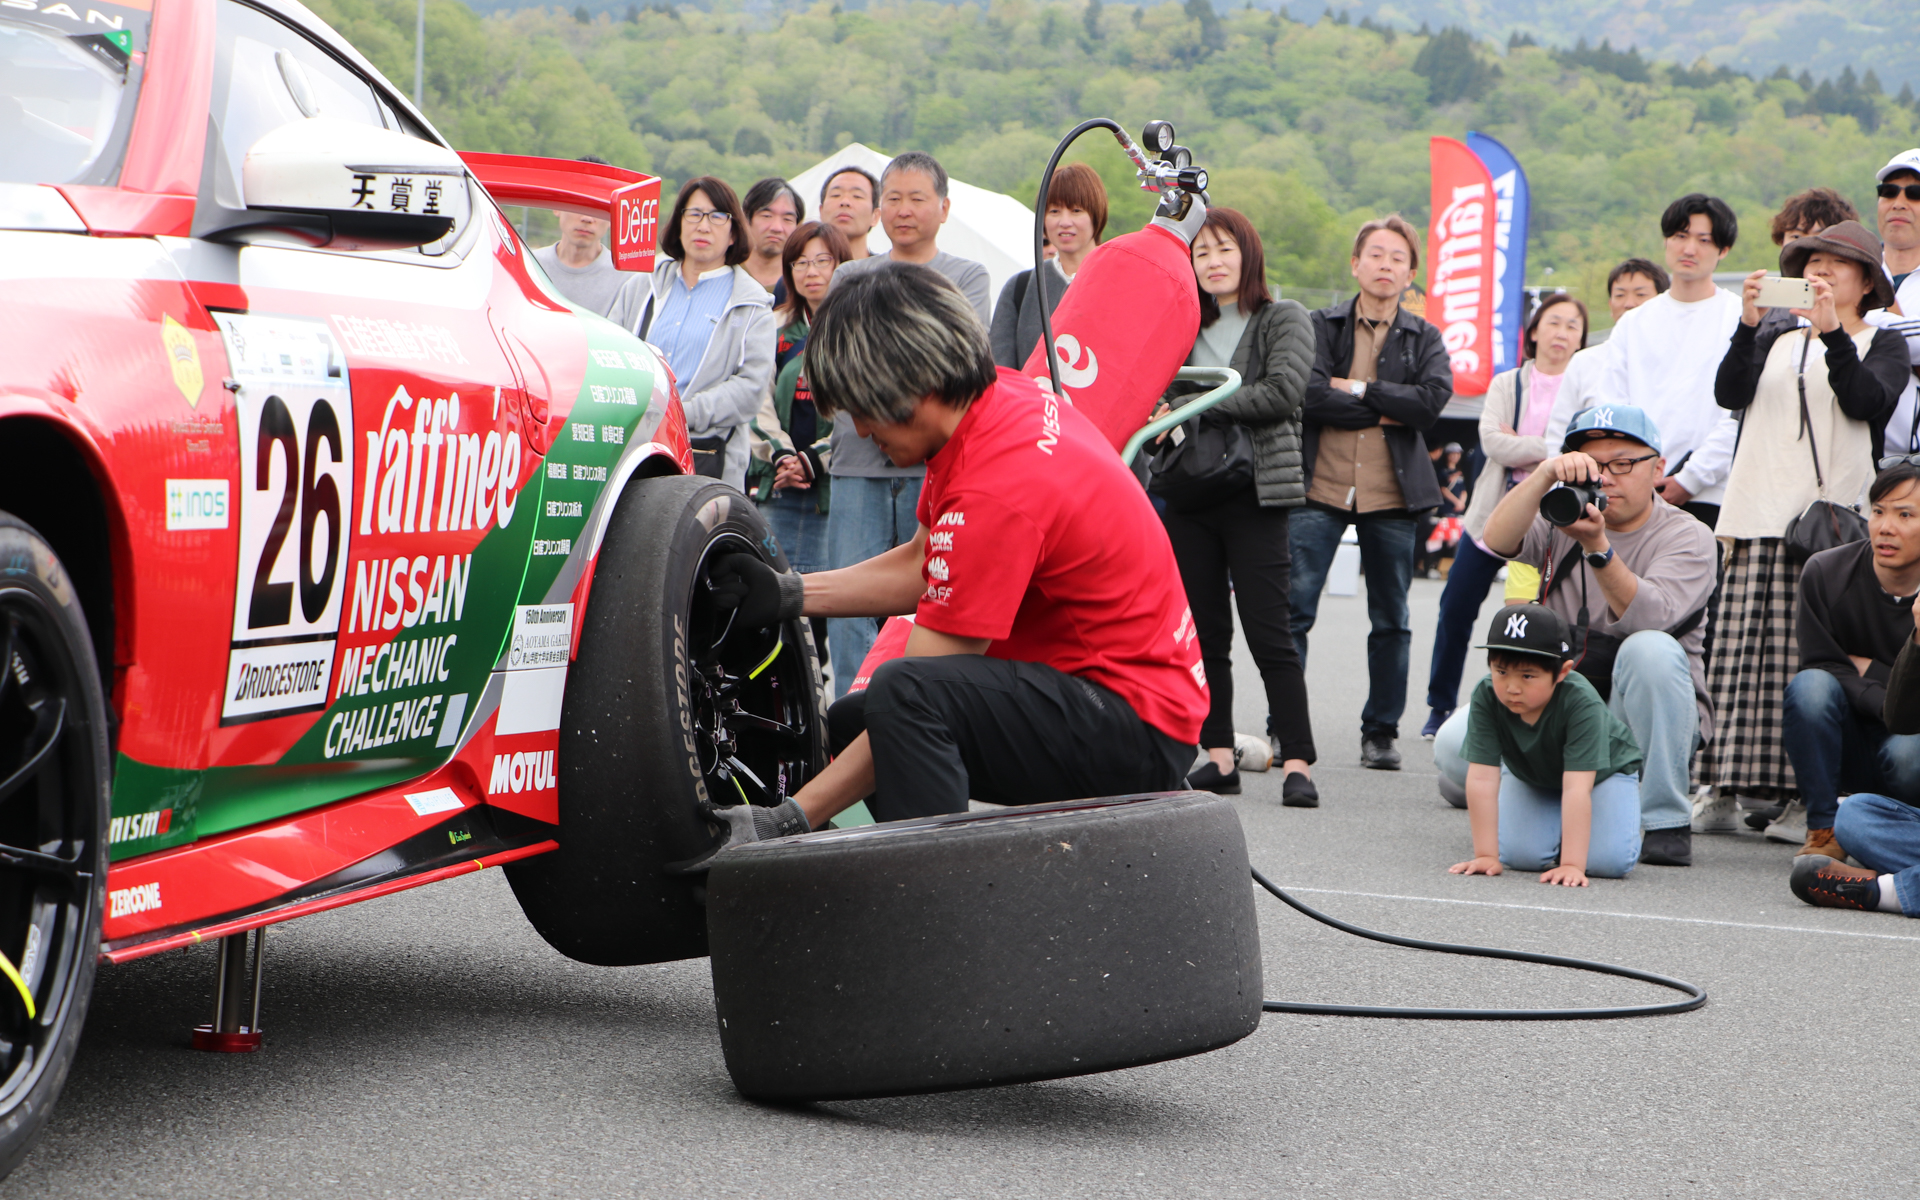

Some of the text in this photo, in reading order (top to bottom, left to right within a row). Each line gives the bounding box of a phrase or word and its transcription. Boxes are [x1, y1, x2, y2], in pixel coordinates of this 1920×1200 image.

[0, 0, 123, 30] SAN
[119, 34, 128, 46] 3
[351, 174, 442, 214] 天賞堂
[329, 313, 470, 365] 日産自動車大学校
[1594, 407, 1614, 428] NY
[247, 395, 343, 630] 26
[937, 511, 966, 526] TUL
[929, 531, 954, 546] NGK
[348, 554, 471, 633] NISSAN
[1504, 613, 1529, 638] NY
[234, 659, 325, 702] BRIDGESTONE
[335, 634, 457, 699] MECHANIC
[324, 694, 443, 758] CHALLENGE
[488, 750, 556, 795] MOTUL
[109, 882, 162, 919] ZEROONE
